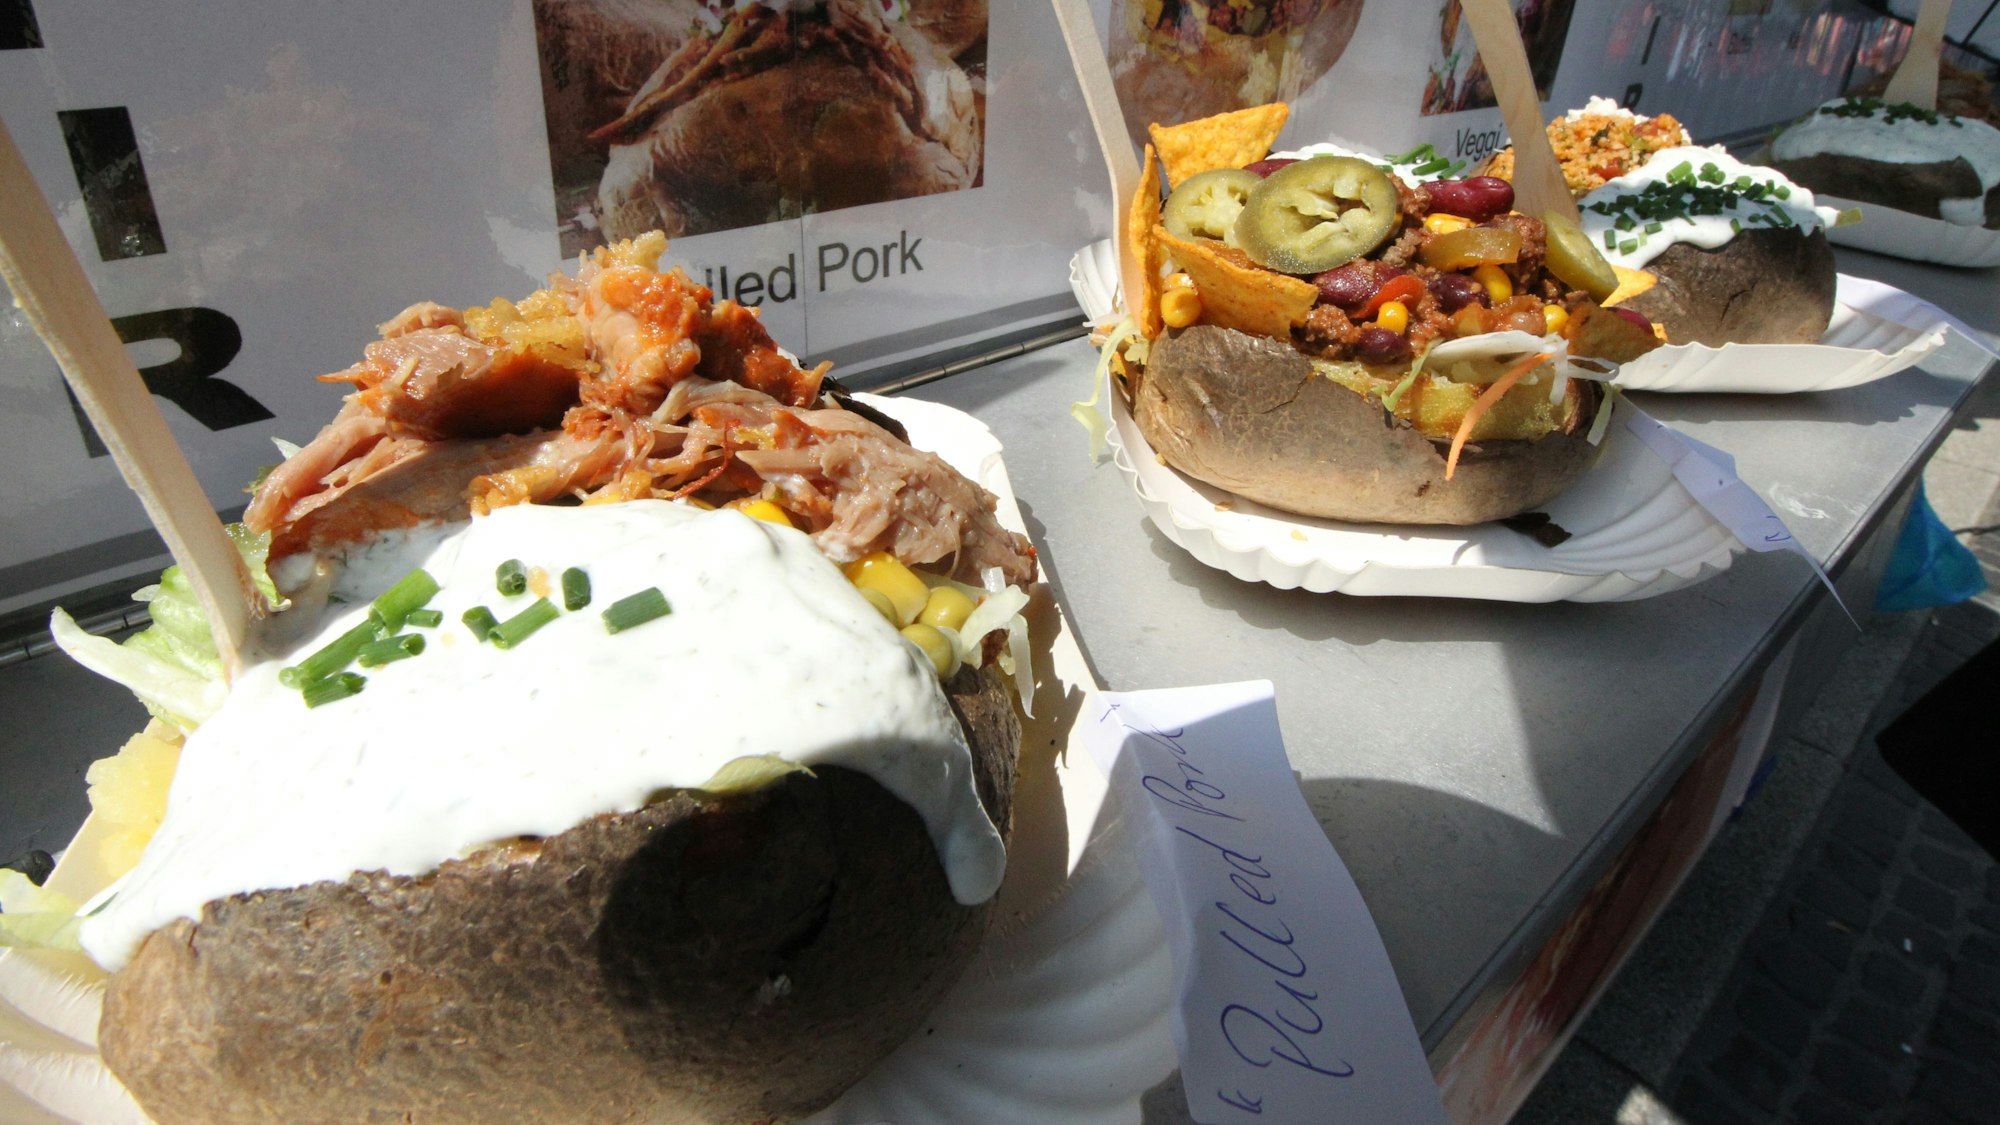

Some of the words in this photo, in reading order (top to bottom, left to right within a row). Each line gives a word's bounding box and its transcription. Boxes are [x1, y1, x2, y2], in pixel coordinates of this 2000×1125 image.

[1457, 122, 1503, 162] Veggi
[705, 253, 796, 308] lled
[818, 230, 924, 292] Pork
